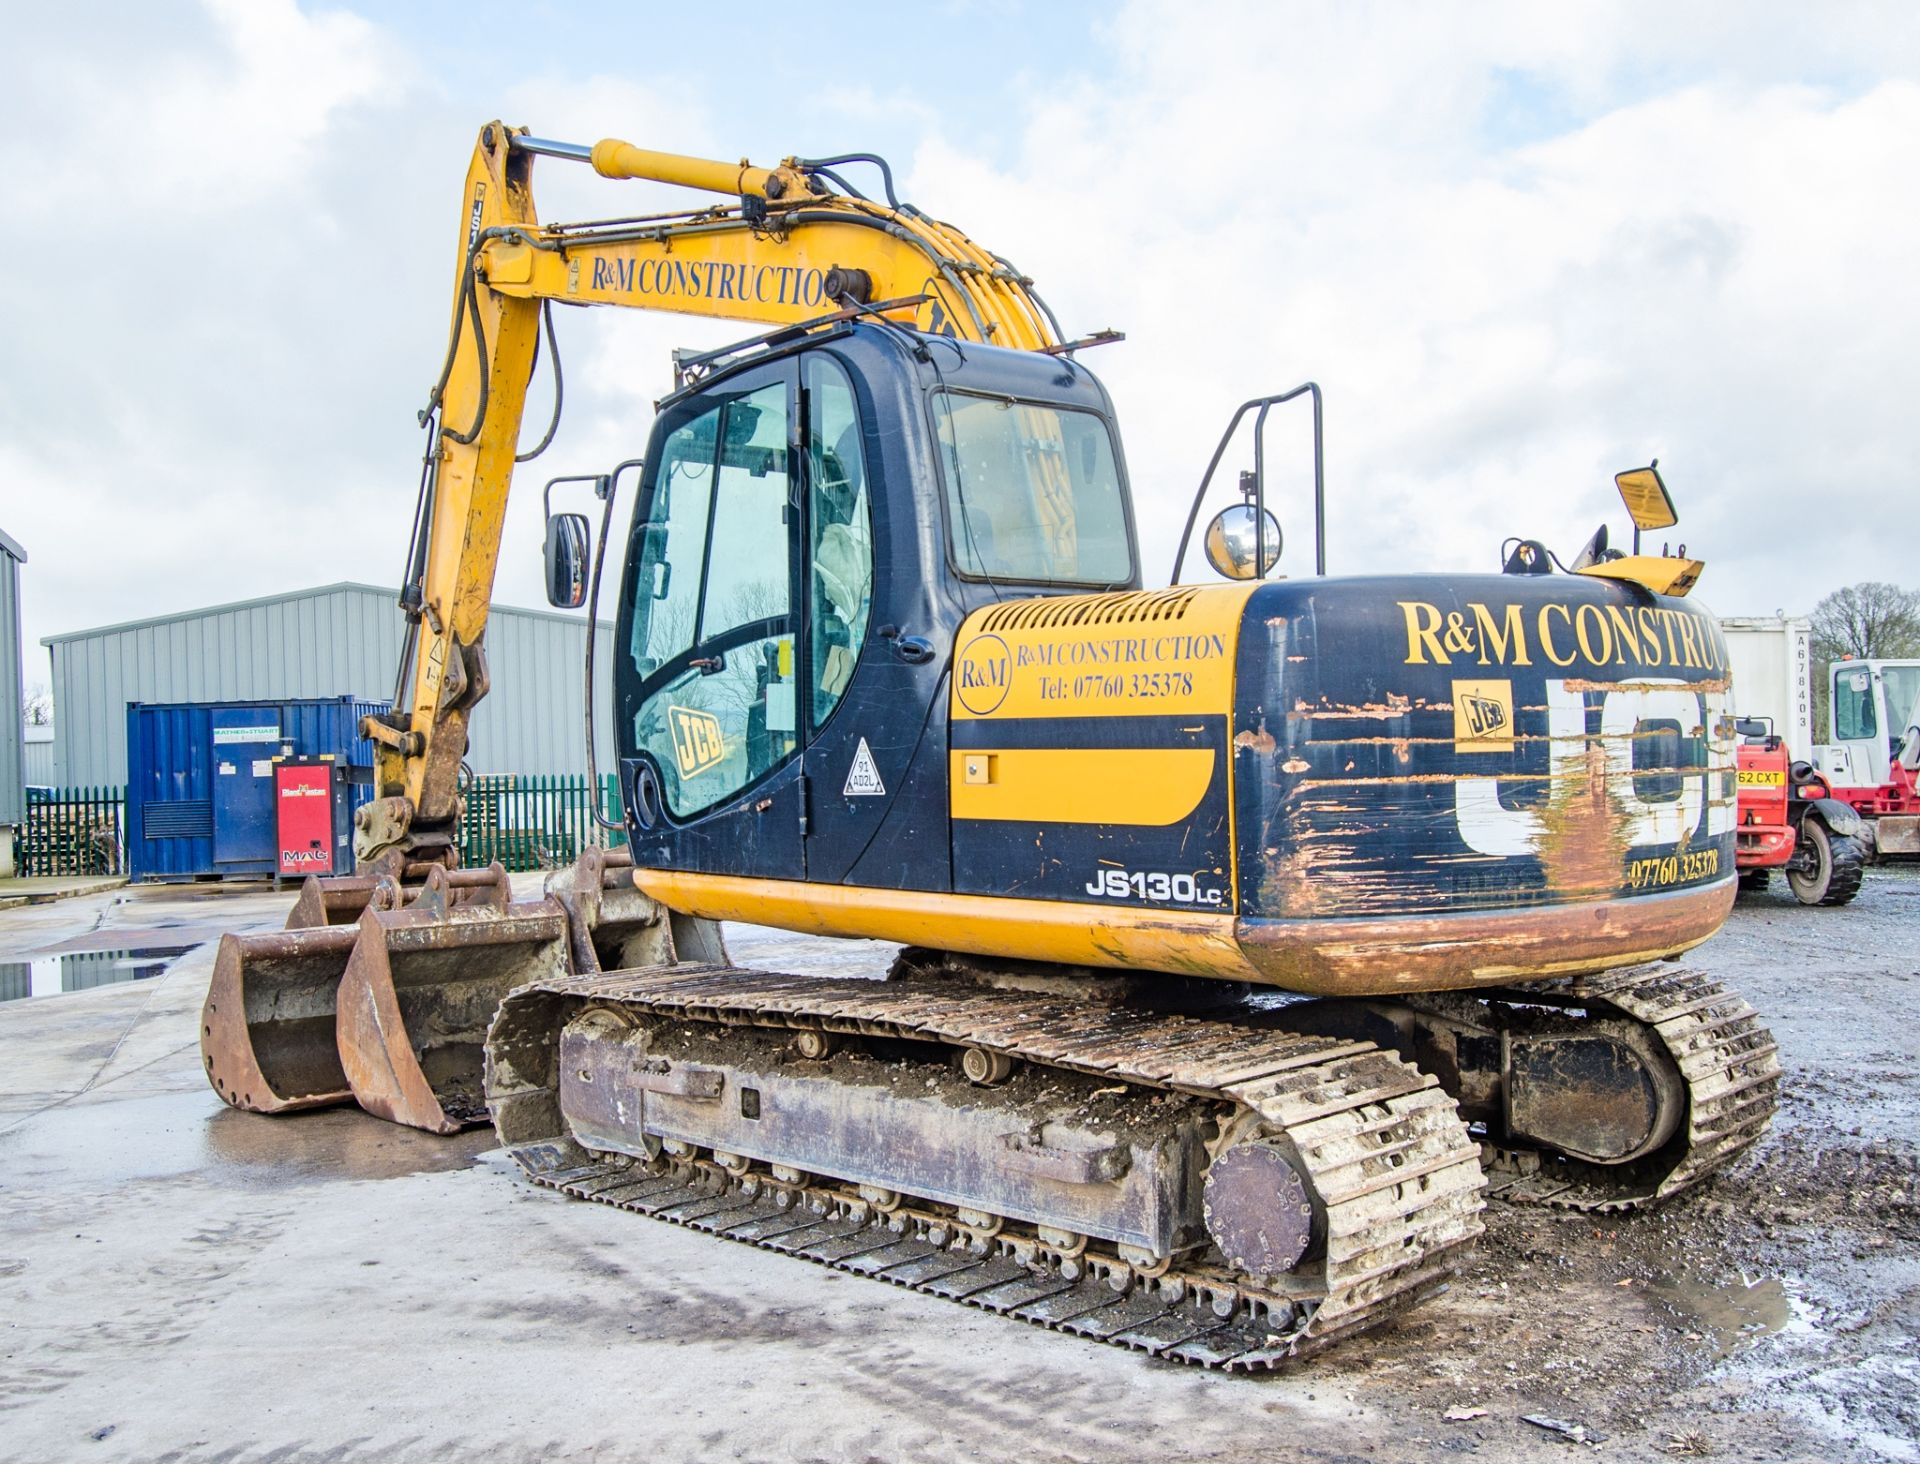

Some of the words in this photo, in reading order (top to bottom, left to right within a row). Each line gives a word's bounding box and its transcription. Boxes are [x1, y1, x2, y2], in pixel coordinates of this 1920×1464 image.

[591, 256, 636, 292] R&M
[638, 258, 829, 307] CONSTRUCTIO
[1017, 643, 1054, 667] R&M
[1057, 634, 1227, 666] CONSTRUCTION
[1397, 600, 1533, 666] R&M
[1537, 603, 1731, 672] CONSTRUC
[961, 657, 1006, 689] R&M
[1039, 676, 1068, 699] Tel:
[1073, 675, 1124, 699] 07760
[1129, 671, 1193, 698] 325378
[1469, 699, 1505, 733] JCB
[678, 713, 721, 771] JCB
[859, 761, 869, 772] 91
[1756, 772, 1780, 783] CXT
[1631, 856, 1678, 888] 07760
[1680, 848, 1719, 882] 325378
